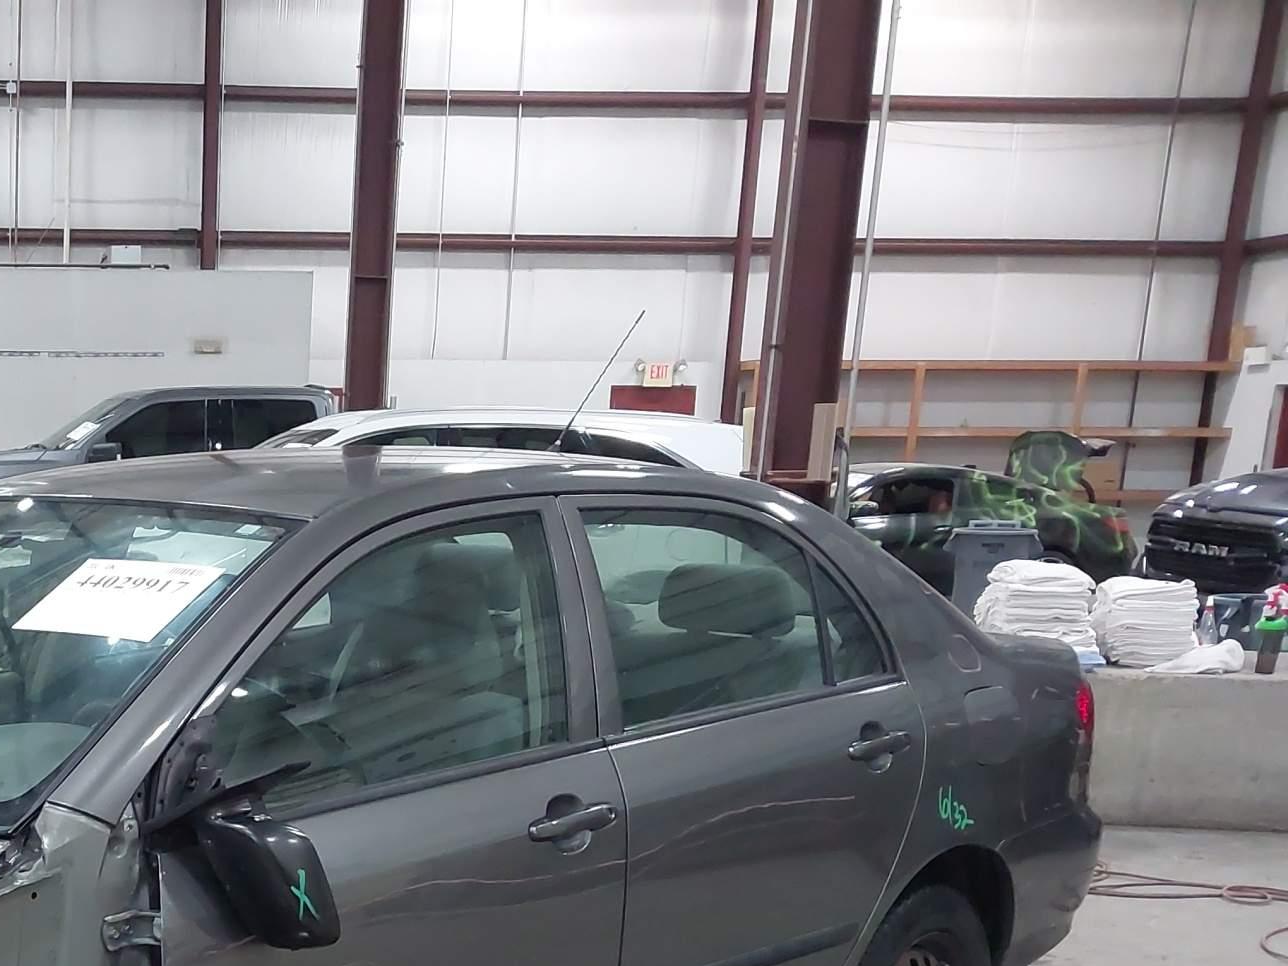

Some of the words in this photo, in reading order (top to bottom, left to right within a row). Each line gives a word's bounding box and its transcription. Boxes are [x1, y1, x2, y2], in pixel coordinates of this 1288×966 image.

[650, 364, 669, 380] EXIT
[1173, 541, 1229, 557] RAM
[76, 574, 190, 594] 44029917
